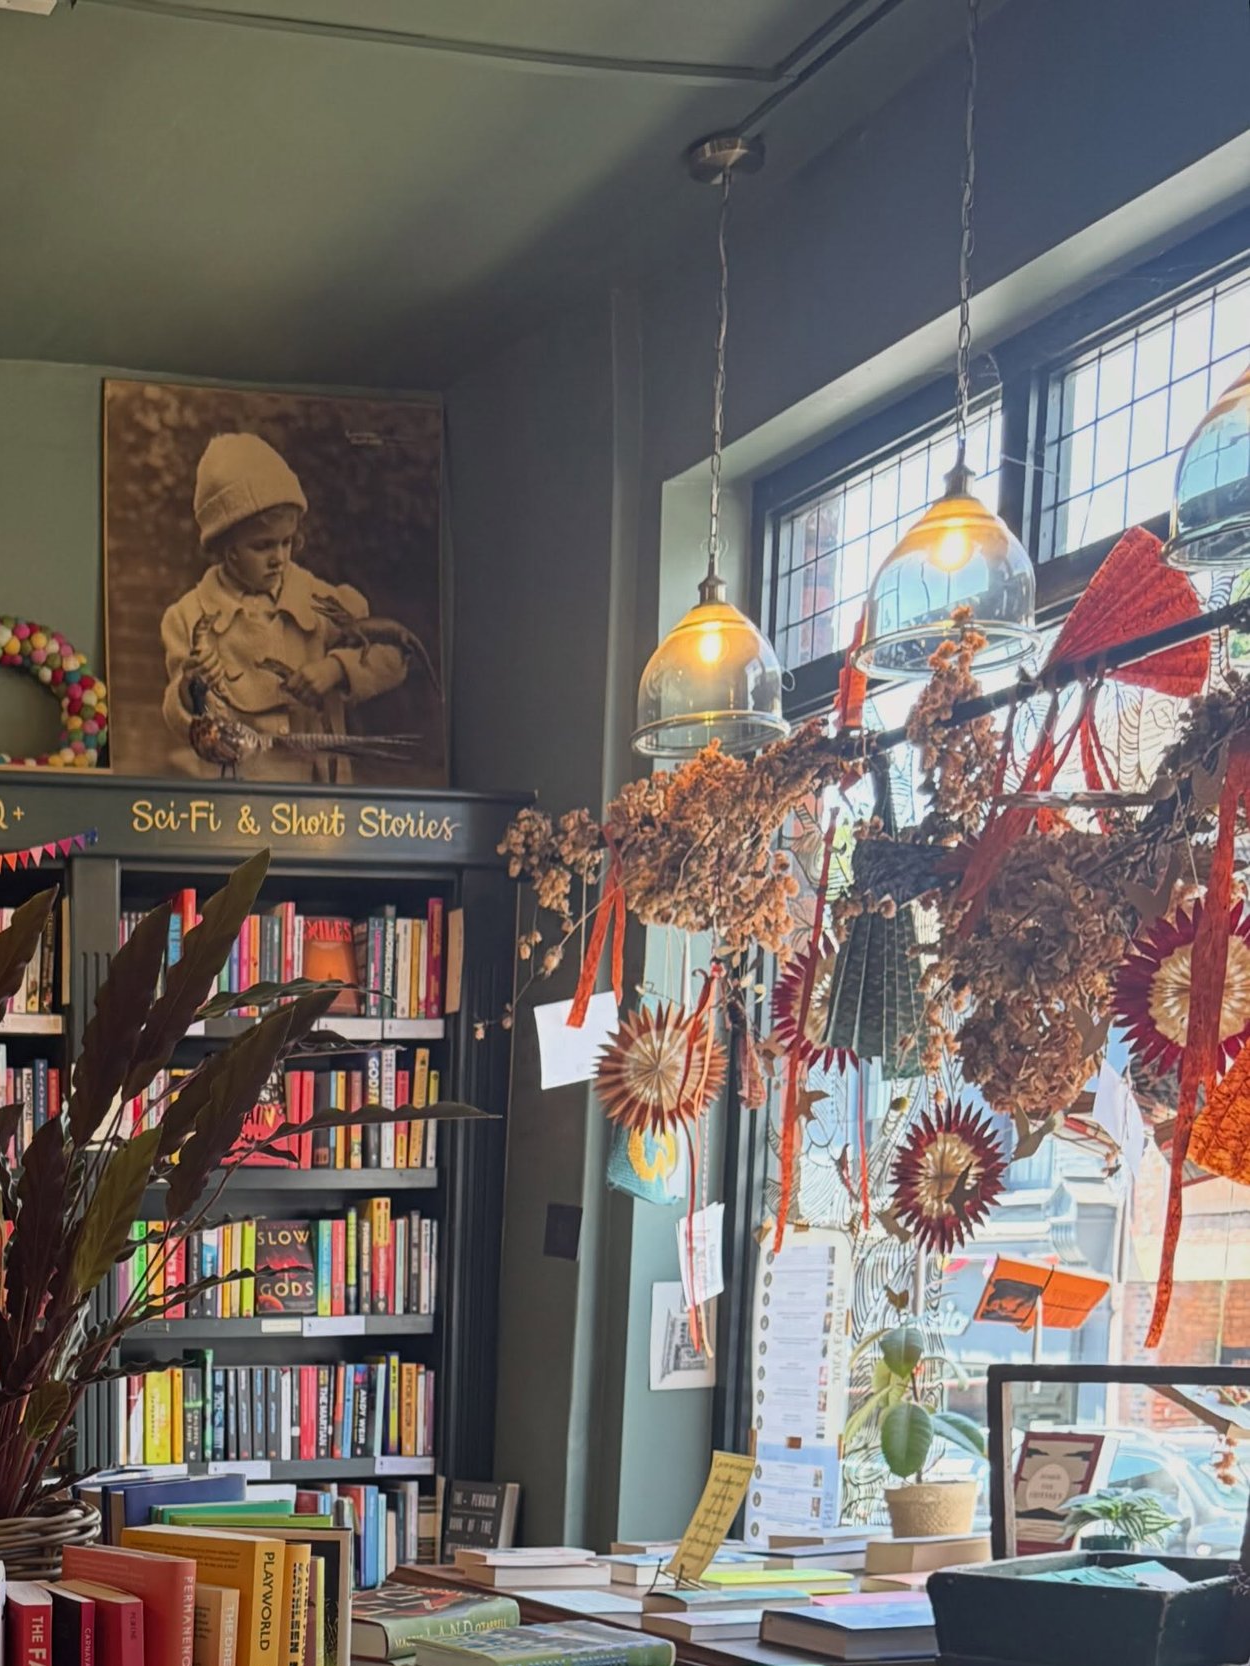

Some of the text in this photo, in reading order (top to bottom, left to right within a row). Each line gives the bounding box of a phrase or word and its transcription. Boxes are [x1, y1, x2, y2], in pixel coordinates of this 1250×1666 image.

[133, 801, 461, 841] Sci-Fi & Short Stories
[302, 918, 352, 942] EXILES
[257, 1230, 310, 1246] SLOW
[260, 1281, 314, 1297] GODS
[320, 1402, 328, 1448] MARTIAN
[358, 1389, 367, 1444] ANDY WEIR
[259, 1551, 276, 1652] PLAYWORLD
[31, 1616, 43, 1643] THE
[224, 1604, 235, 1635] THE
